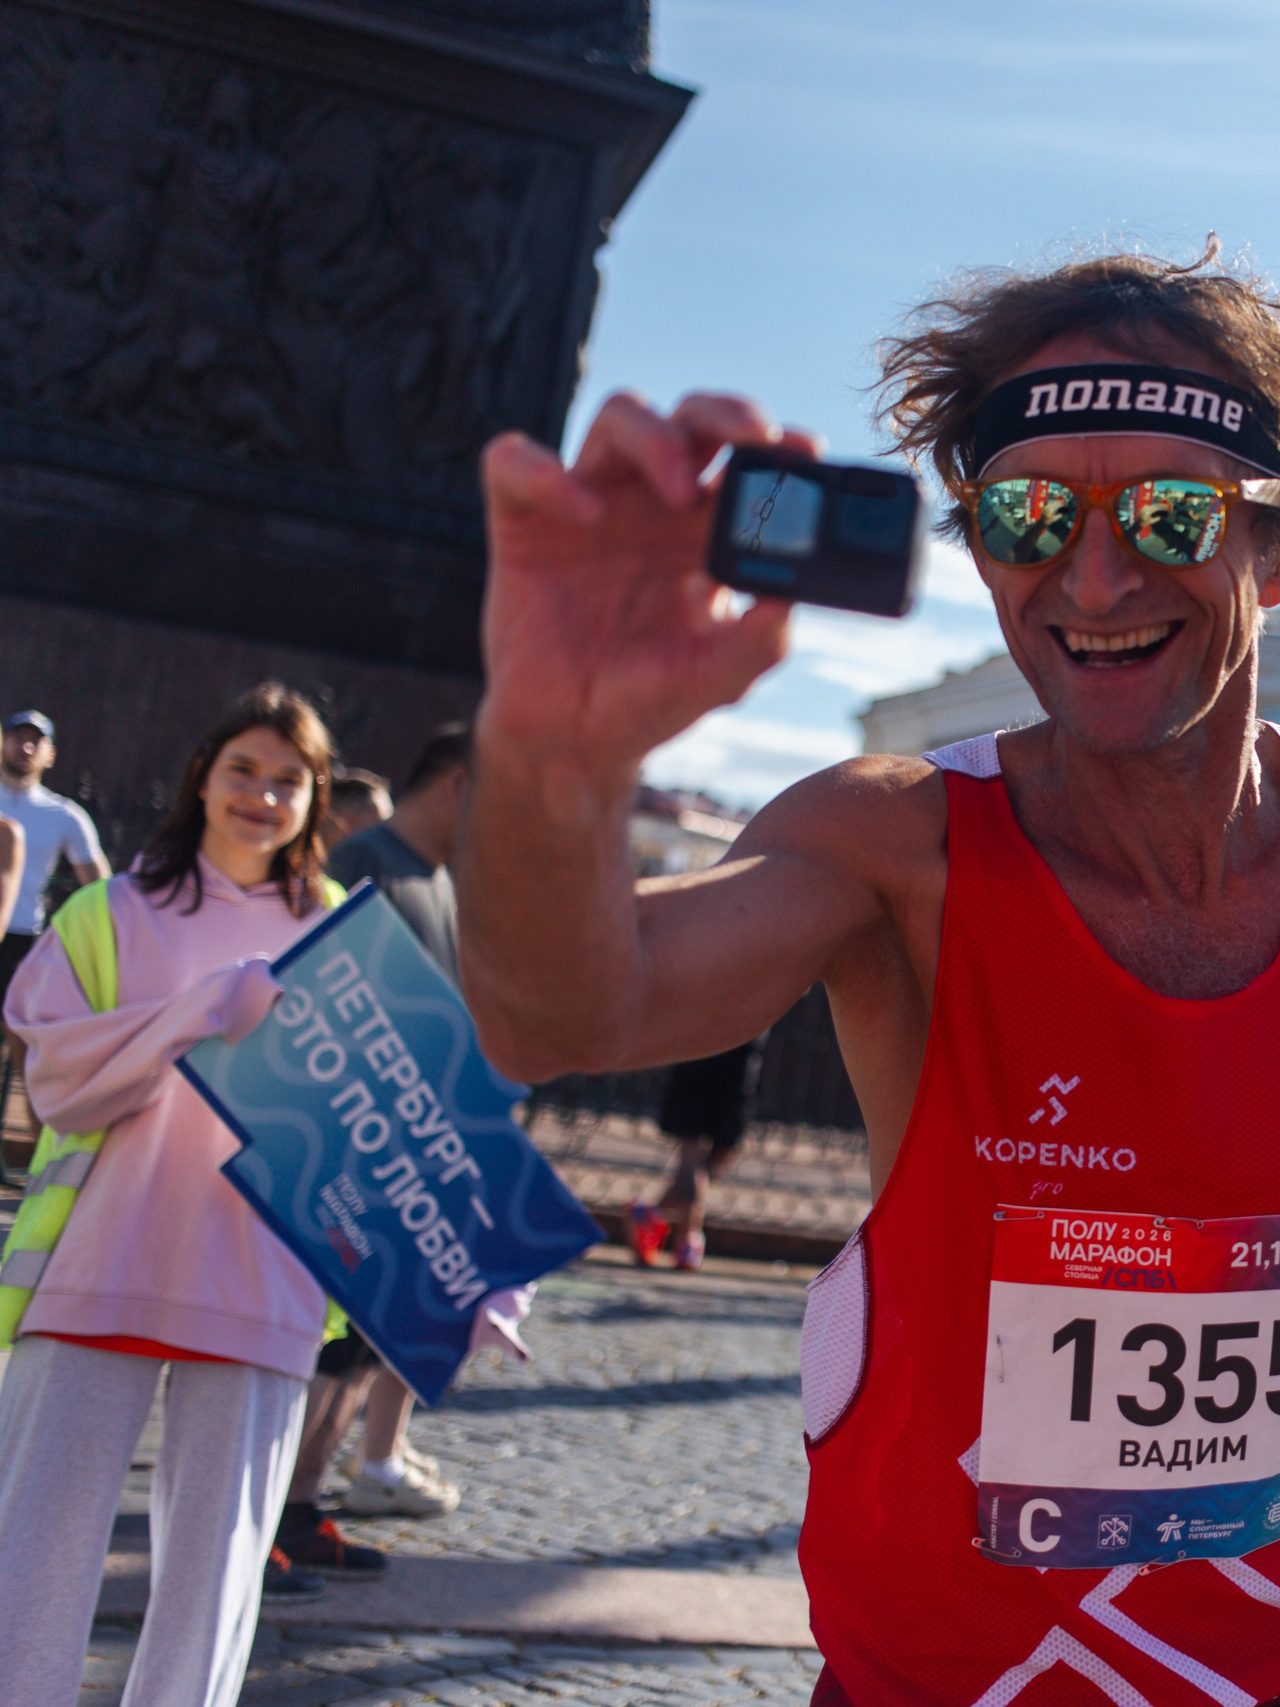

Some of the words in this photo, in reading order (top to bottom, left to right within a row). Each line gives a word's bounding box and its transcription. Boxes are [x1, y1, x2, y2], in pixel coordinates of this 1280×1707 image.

[1025, 379, 1244, 432] noname
[316, 952, 482, 1186] ПЕТЕРБУРГ
[272, 988, 347, 1082] ЭТО
[329, 1078, 391, 1153] ПО
[372, 1153, 489, 1311] ЛЮБВИ
[1051, 1218, 1118, 1242] ПОЛУ
[1121, 1227, 1172, 1242] 2026
[1049, 1240, 1172, 1267] МАРАФОН
[1064, 1263, 1103, 1273] СЕВЕРНАЯ
[1064, 1270, 1100, 1280] СТОЛИЦА
[1118, 1434, 1248, 1472] ВАДИМ
[1188, 1530, 1233, 1539] ПЕТЕРБУРГ
[1189, 1520, 1245, 1532] СПОРТИВНЫЙ
